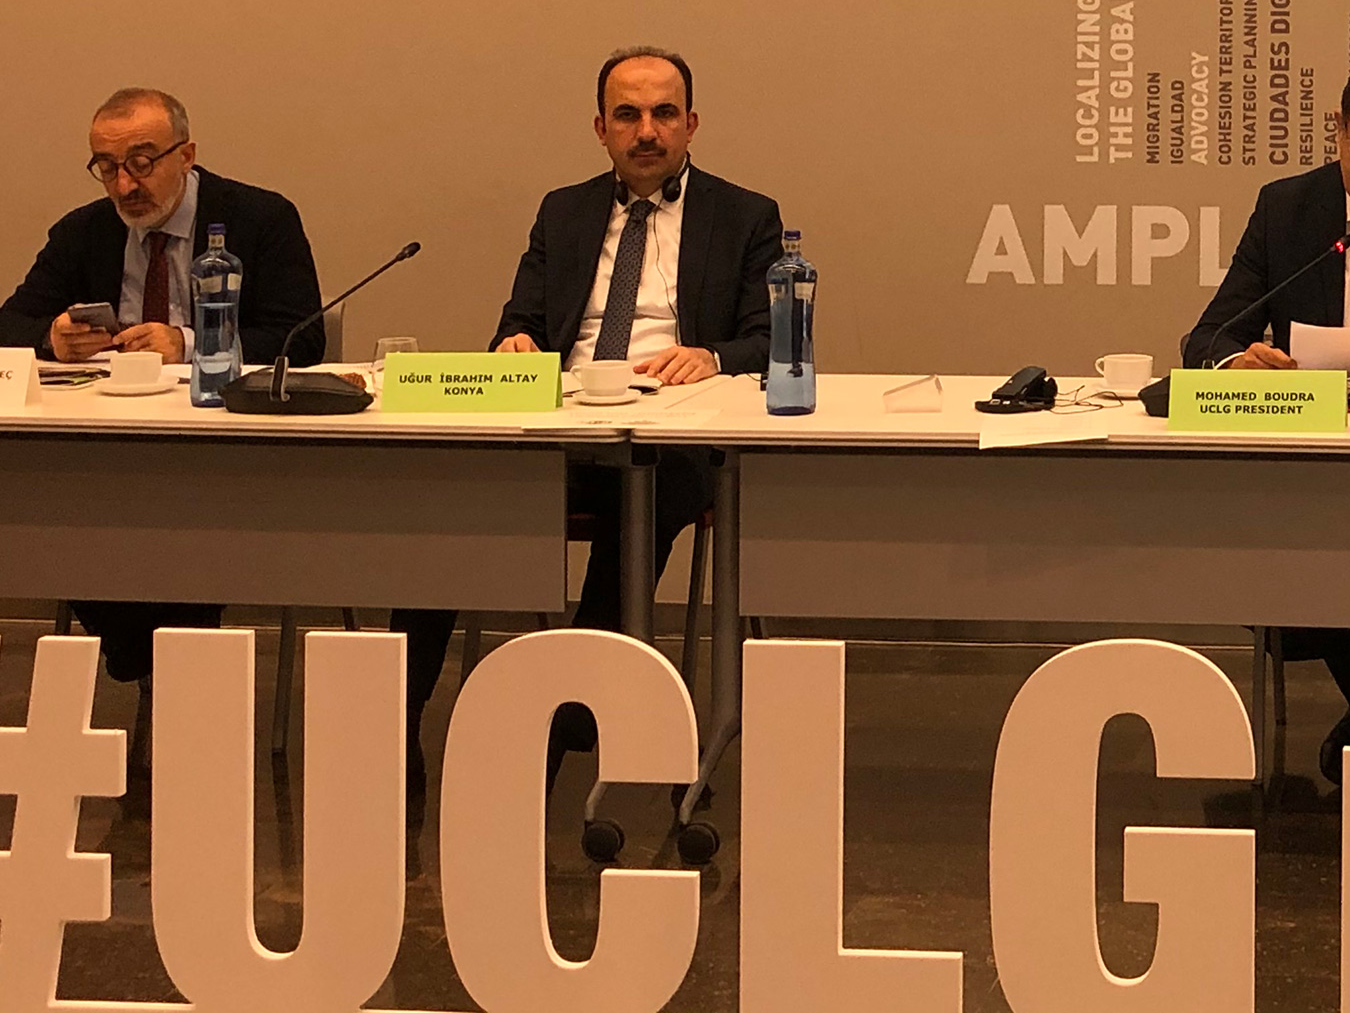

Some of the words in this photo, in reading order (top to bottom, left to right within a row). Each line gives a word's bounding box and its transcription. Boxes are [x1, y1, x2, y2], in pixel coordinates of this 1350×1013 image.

[1109, 105, 1134, 164] THE
[1145, 72, 1161, 165] MIGRATION
[1169, 79, 1185, 165] IGUALDAD
[1189, 51, 1210, 166] ADVOCACY
[1218, 80, 1233, 166] COHESION
[1241, 73, 1257, 166] STRATEGIC
[1268, 40, 1291, 166] CIUDADES
[1299, 66, 1315, 166] RESILIENCE
[399, 372, 432, 384] UĞUR
[499, 373, 538, 383] ALTAY
[443, 386, 484, 396] KONYA
[1195, 391, 1257, 402] MOHAMED
[1264, 392, 1315, 402] BOUDRA
[1199, 404, 1232, 414] UCLG
[1235, 404, 1304, 415] PRESIDENT
